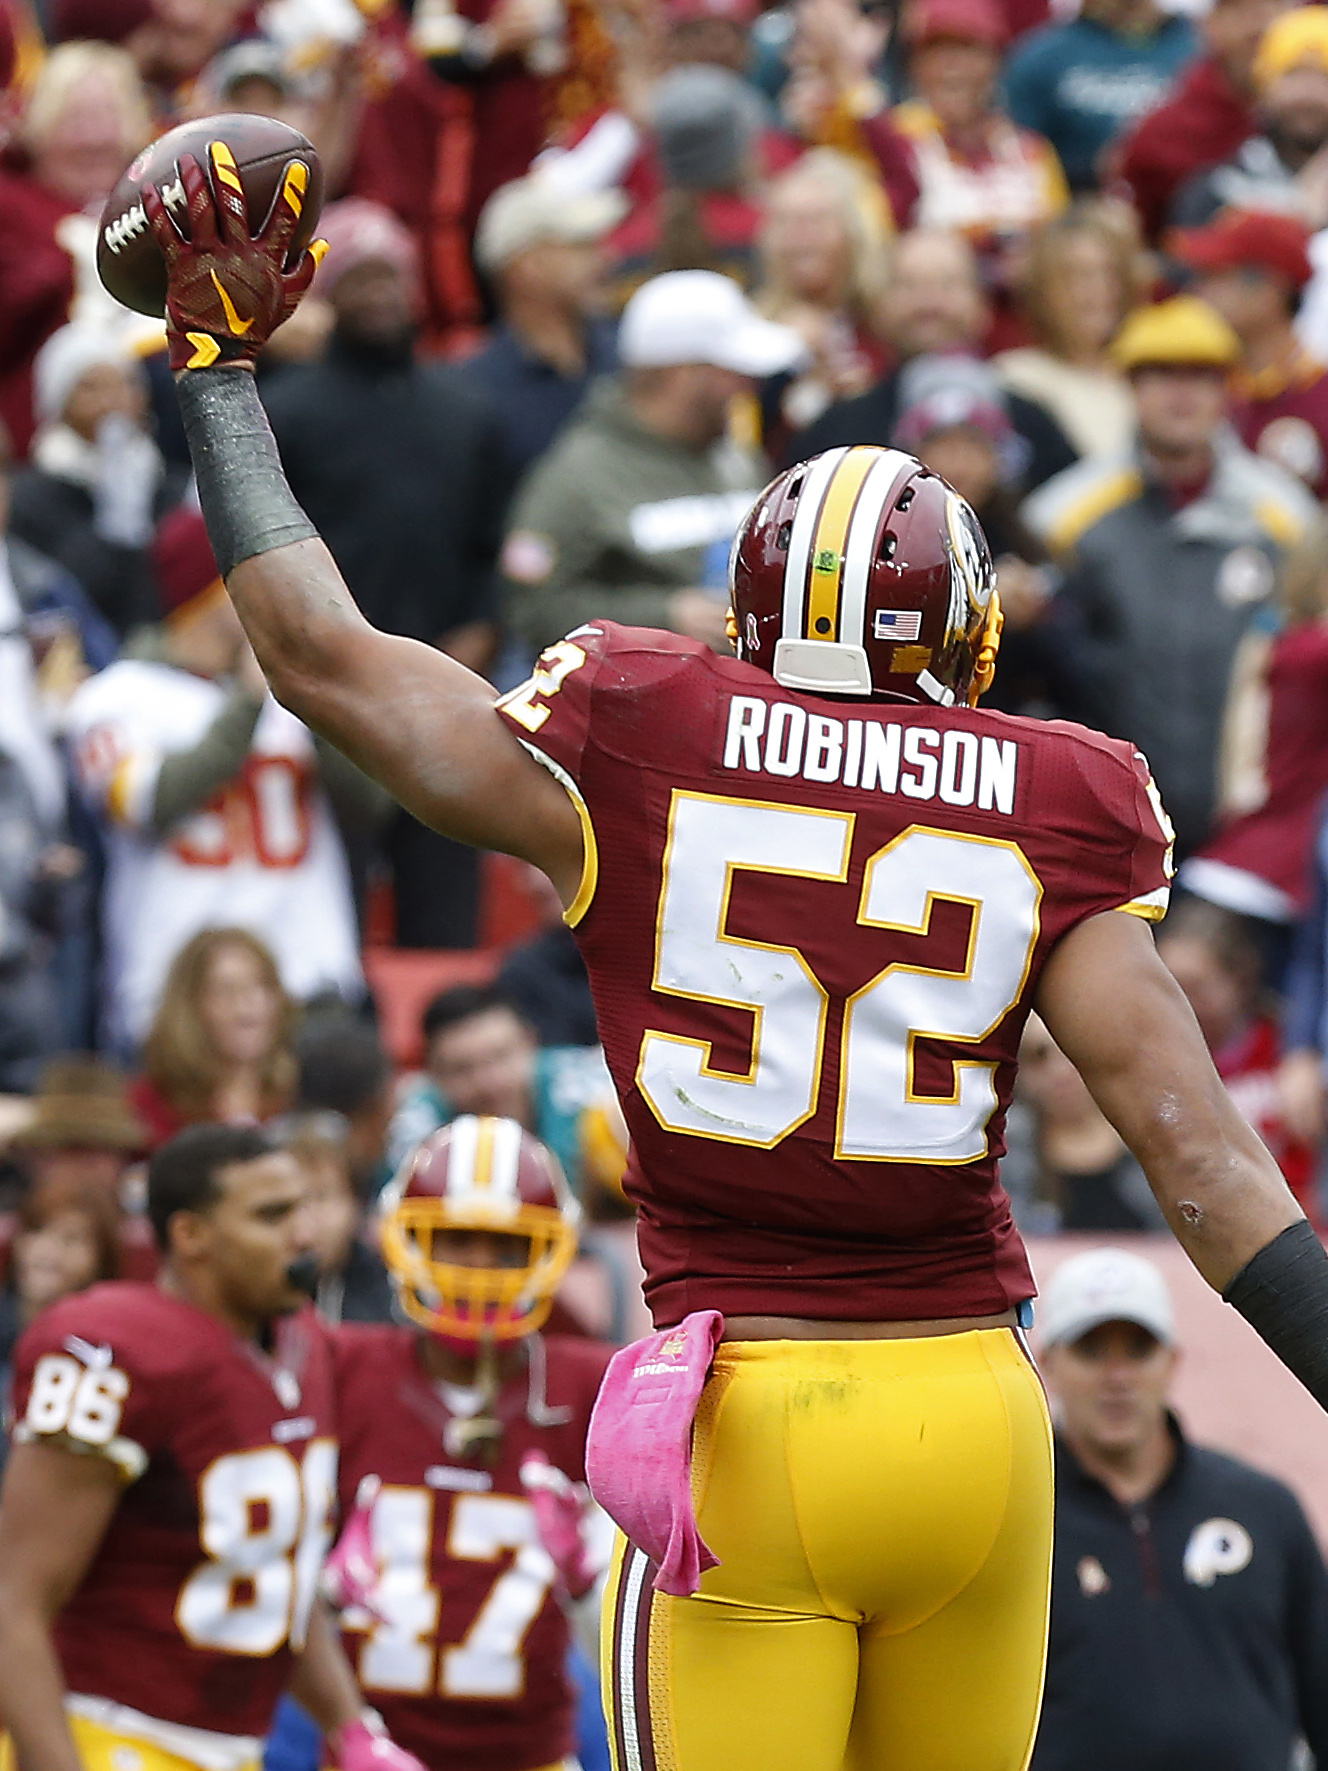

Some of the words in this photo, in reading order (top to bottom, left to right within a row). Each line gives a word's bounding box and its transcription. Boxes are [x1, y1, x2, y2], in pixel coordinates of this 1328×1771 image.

[494, 640, 586, 733] 2
[723, 695, 1018, 815] ROBINSON
[635, 788, 1044, 1166] 52
[27, 1353, 131, 1444] 86
[338, 1483, 559, 1699] 47
